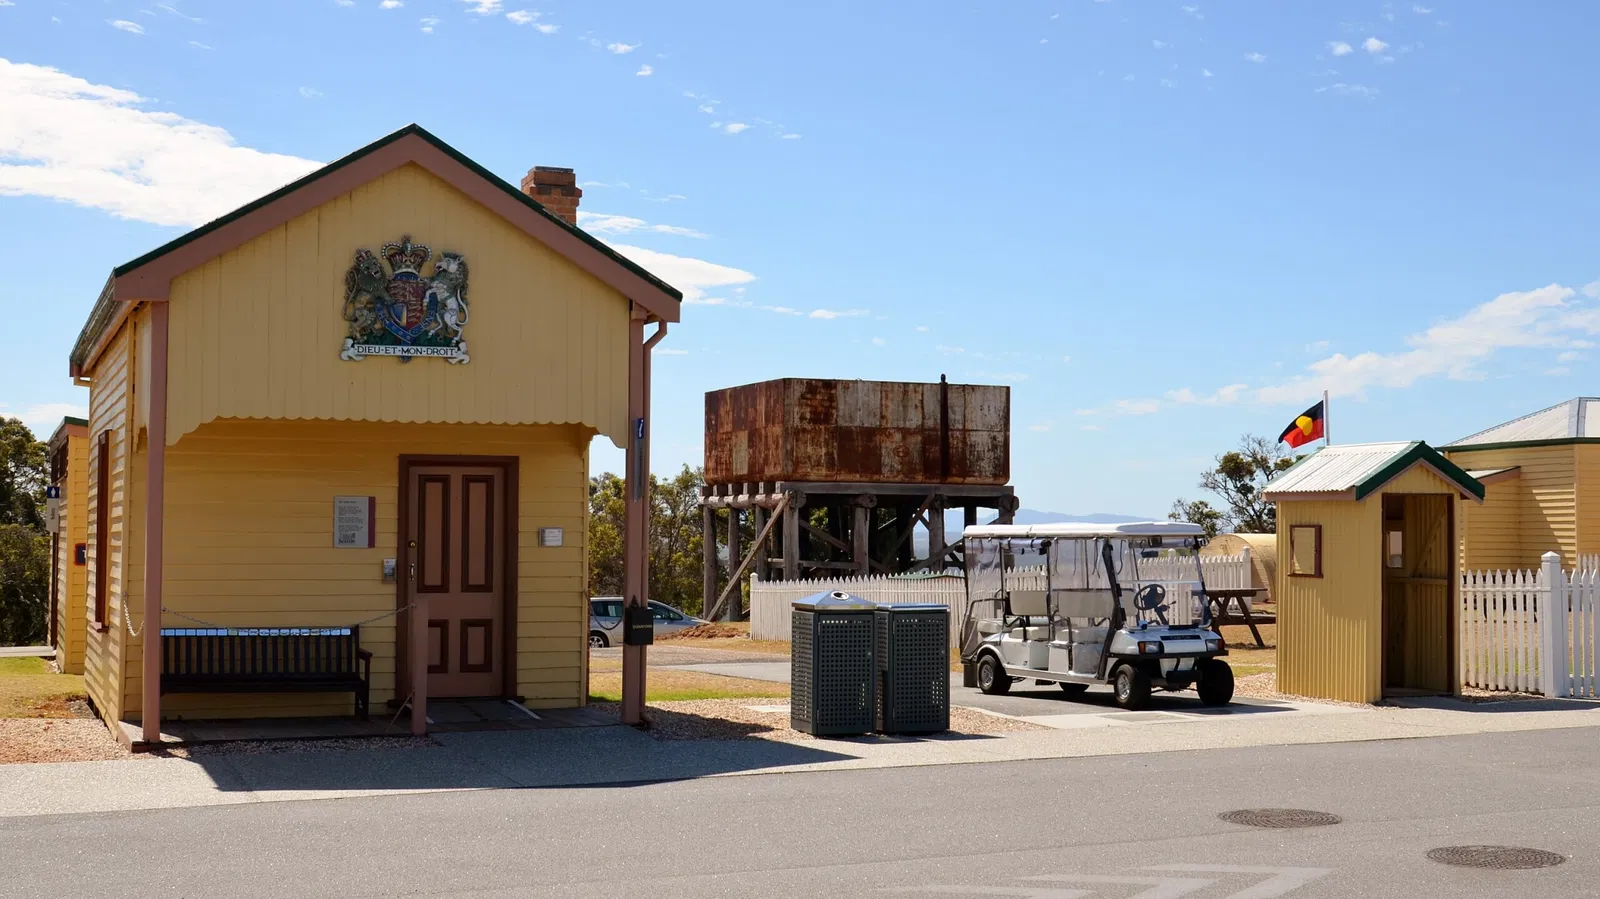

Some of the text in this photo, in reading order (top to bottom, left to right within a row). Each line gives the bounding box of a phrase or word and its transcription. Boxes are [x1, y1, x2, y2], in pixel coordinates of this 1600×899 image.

[357, 346, 456, 356] DIEU ET MON DROIT
